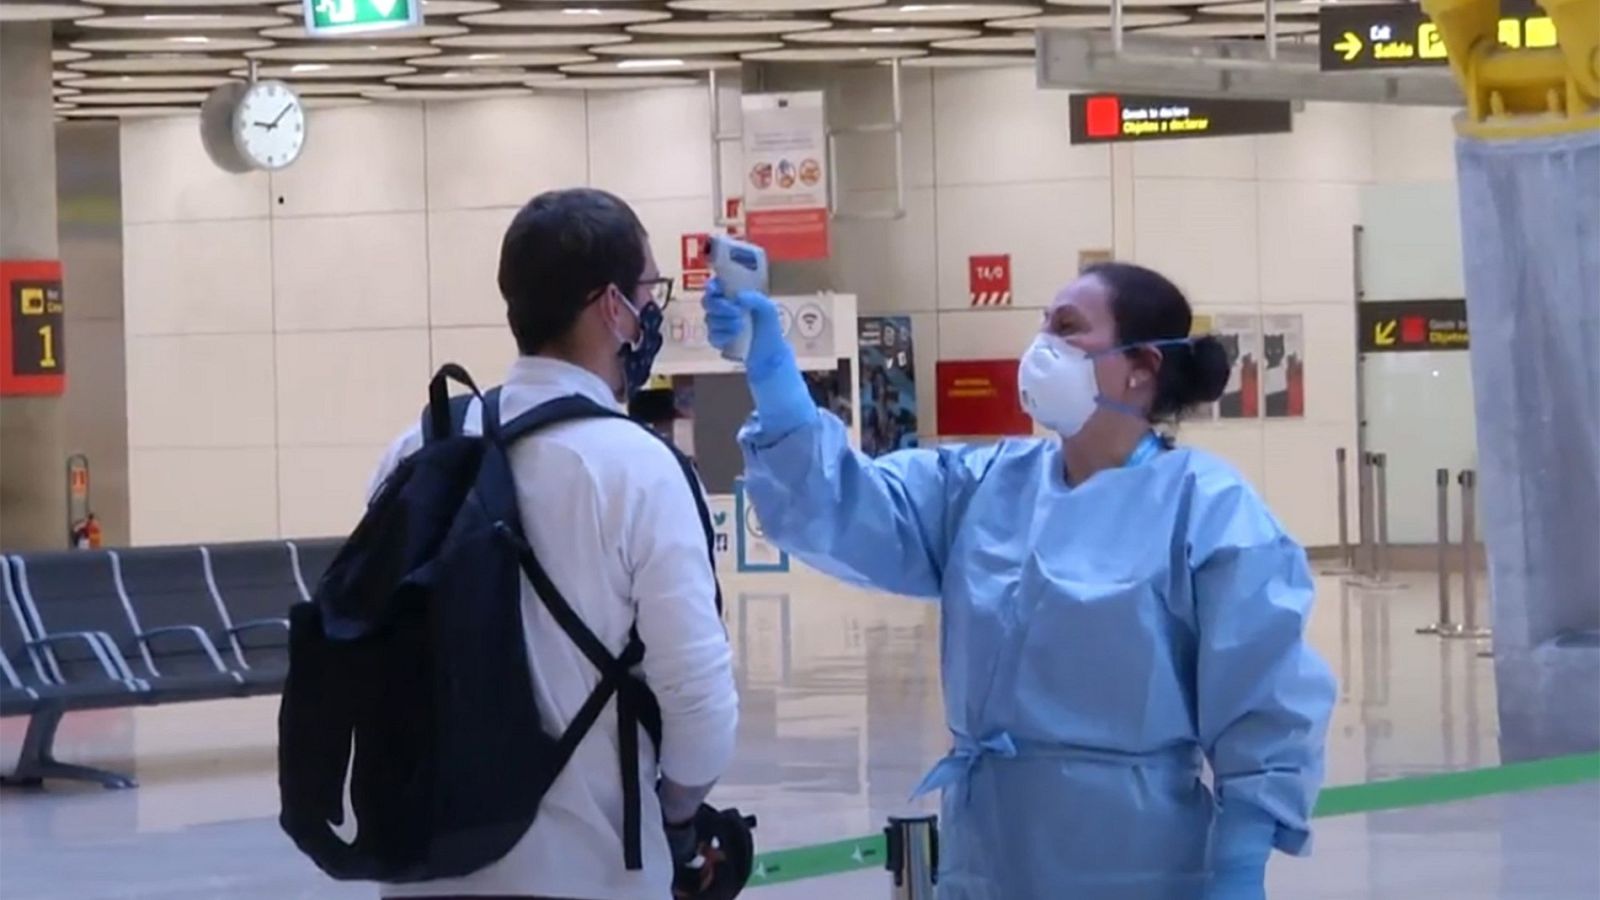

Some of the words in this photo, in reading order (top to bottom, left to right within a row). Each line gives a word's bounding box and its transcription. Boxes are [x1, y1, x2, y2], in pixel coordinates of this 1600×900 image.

[1123, 121, 1159, 134] Objetos
[1169, 119, 1208, 131] declarar
[38, 325, 56, 368] 1
